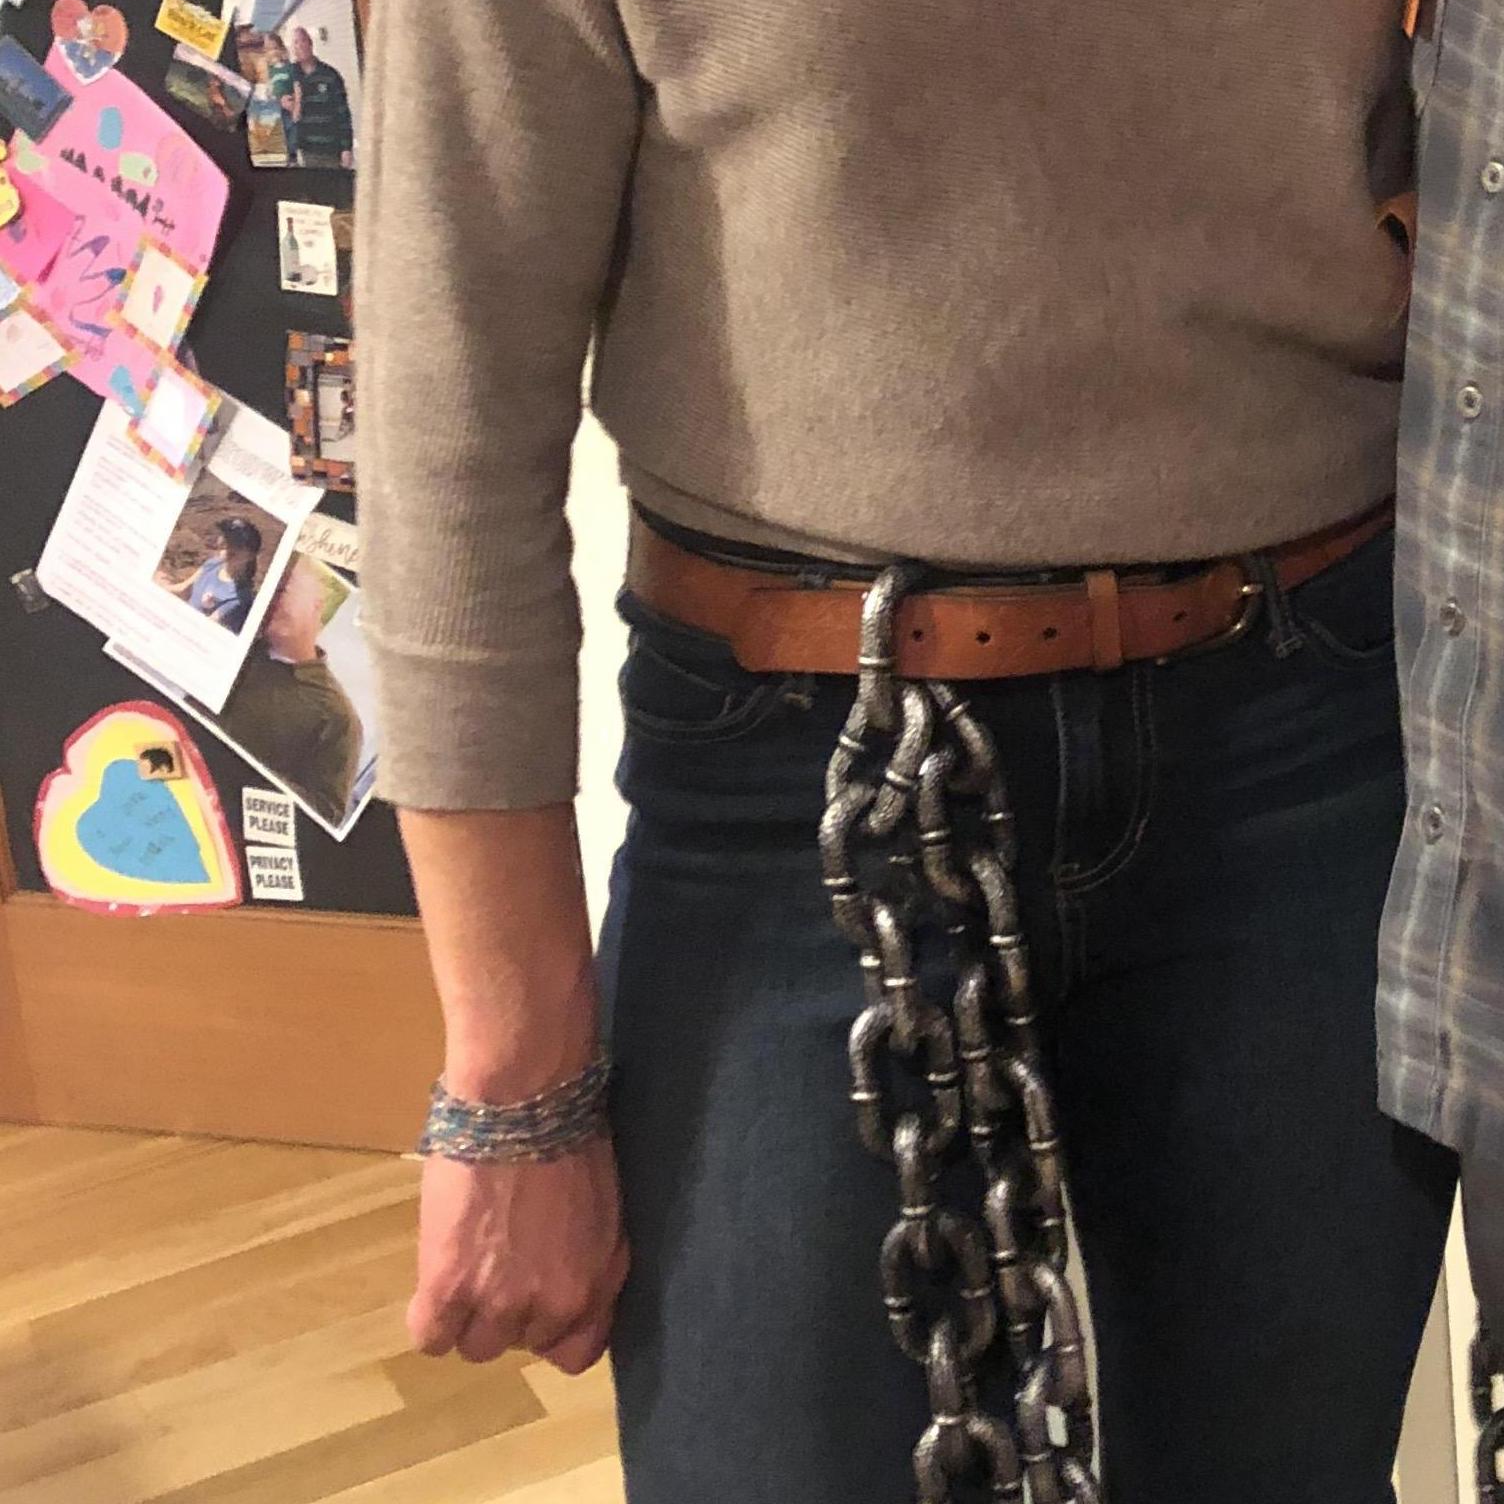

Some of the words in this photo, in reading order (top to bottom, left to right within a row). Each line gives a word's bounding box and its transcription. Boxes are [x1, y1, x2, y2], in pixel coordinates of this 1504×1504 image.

[246, 798, 289, 818] SERVICE
[249, 815, 288, 836] PLEASE
[250, 855, 293, 871] PRIVACY
[256, 873, 295, 890] PLEASE
